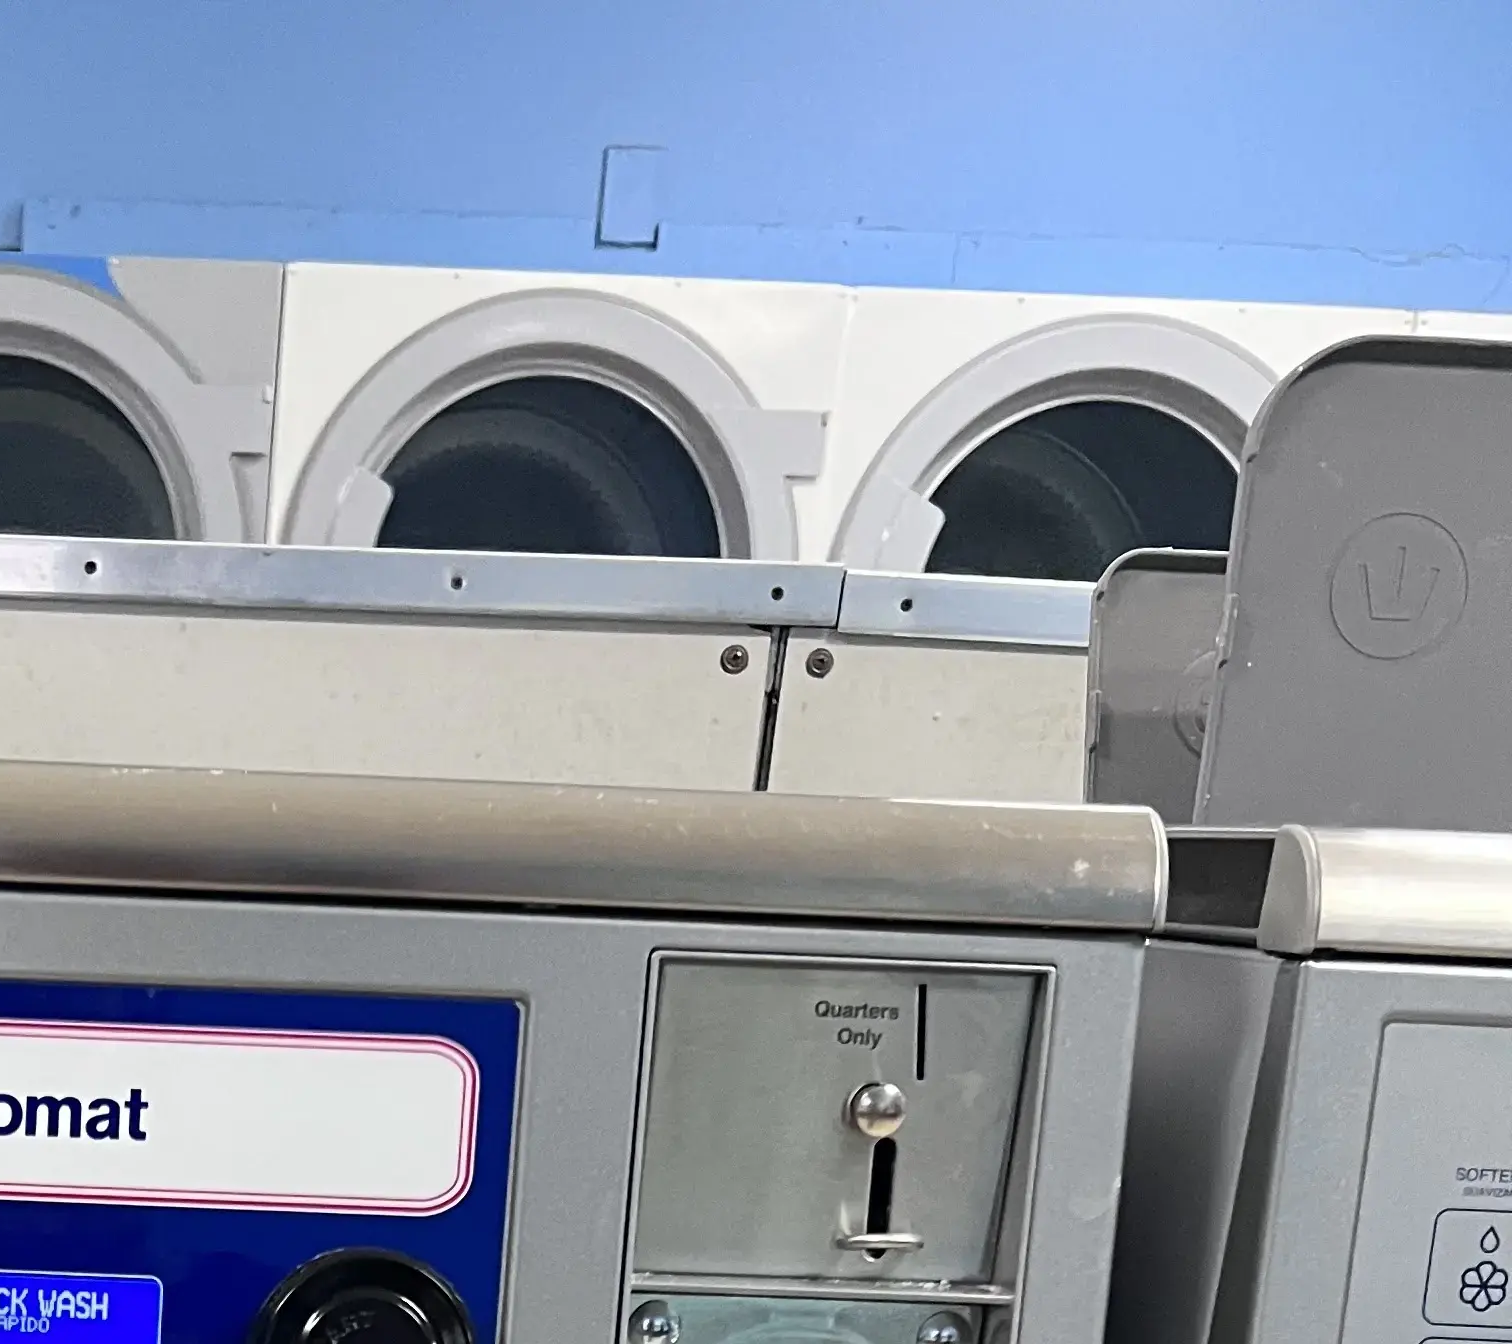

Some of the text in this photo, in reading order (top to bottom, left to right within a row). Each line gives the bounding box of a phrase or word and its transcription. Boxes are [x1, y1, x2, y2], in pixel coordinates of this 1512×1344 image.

[815, 1000, 900, 1020] Quarters
[837, 1027, 883, 1050] Only
[1456, 1167, 1512, 1183] SOFTE
[38, 1289, 109, 1320] WASH
